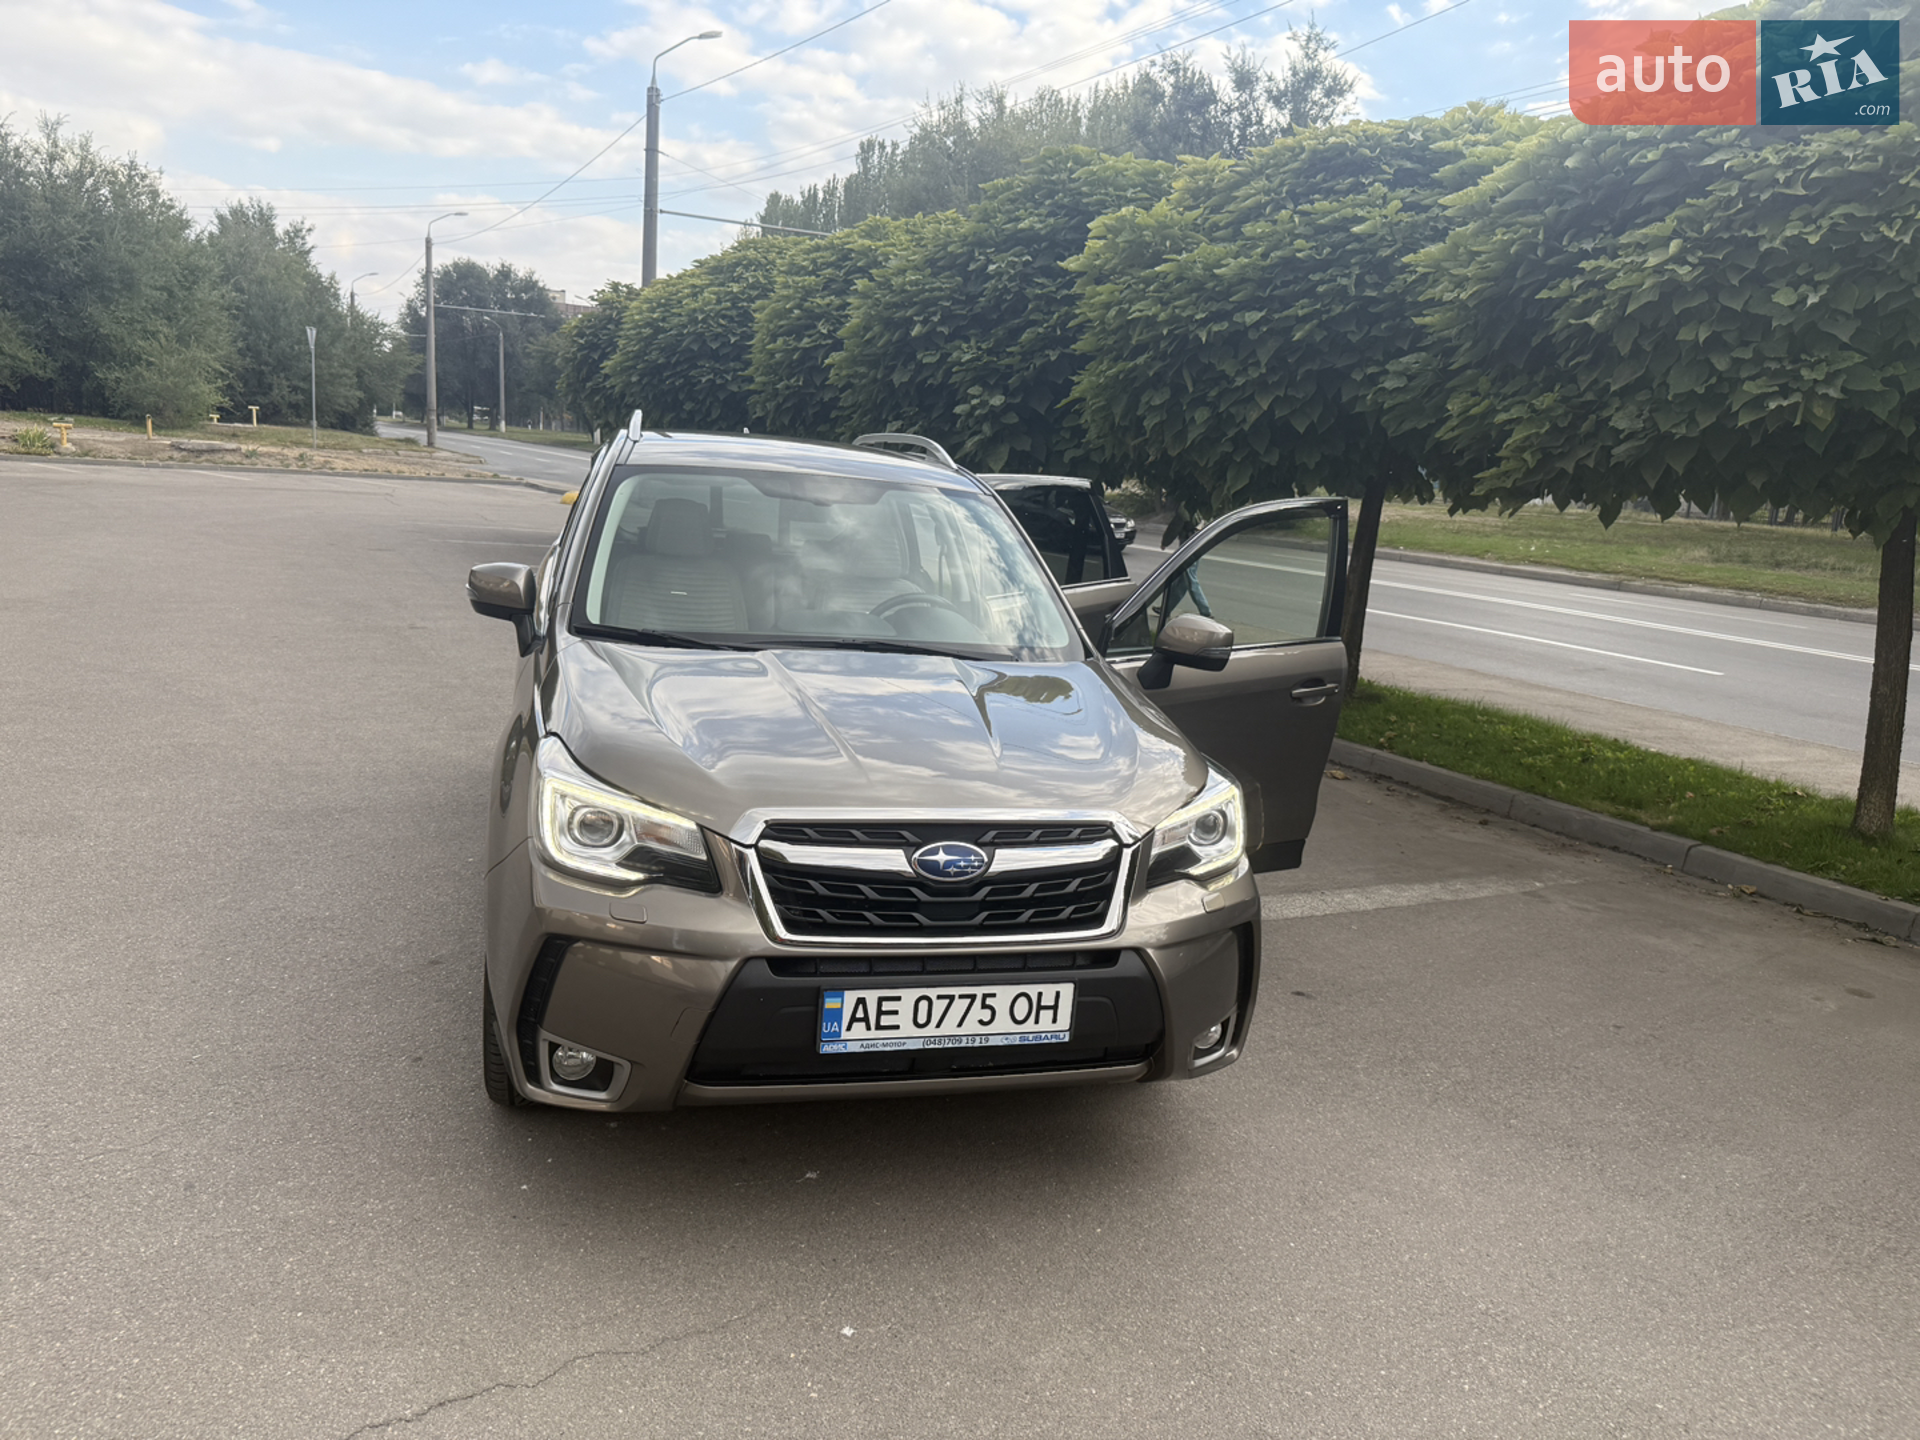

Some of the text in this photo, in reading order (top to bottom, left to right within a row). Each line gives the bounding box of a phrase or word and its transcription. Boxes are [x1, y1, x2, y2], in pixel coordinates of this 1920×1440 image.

[845, 990, 1061, 1032] AE 0775 OH
[822, 1021, 840, 1033] UA
[921, 1036, 990, 1049] (048)709 19 19
[1018, 1033, 1067, 1043] SUBARU
[859, 1041, 907, 1050] АДИС-МОТОР
